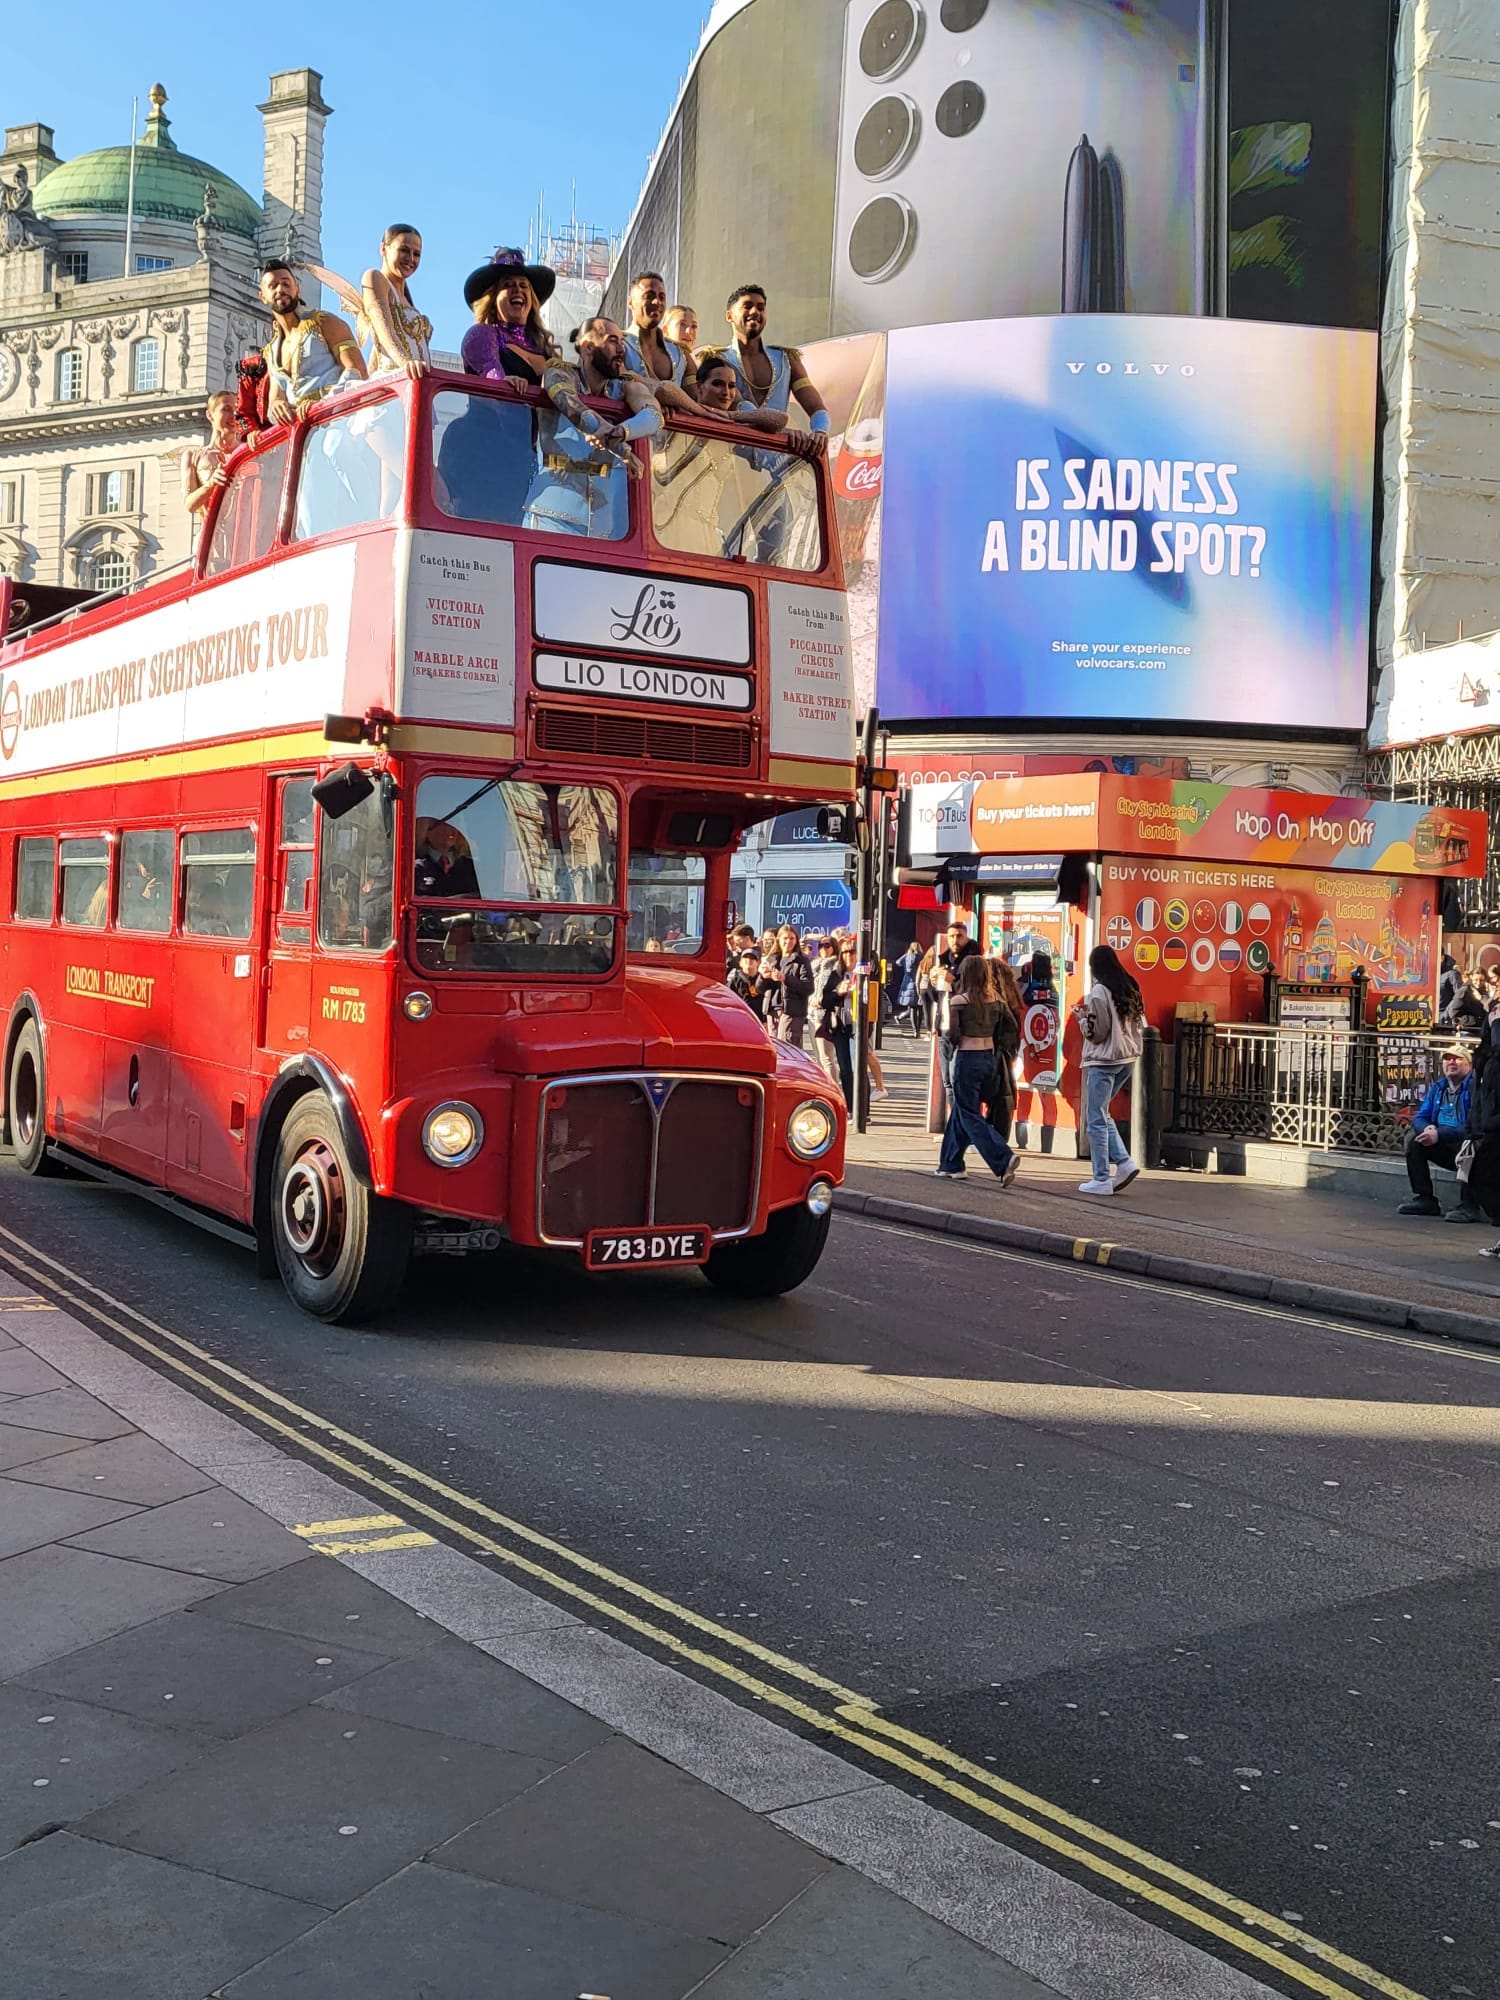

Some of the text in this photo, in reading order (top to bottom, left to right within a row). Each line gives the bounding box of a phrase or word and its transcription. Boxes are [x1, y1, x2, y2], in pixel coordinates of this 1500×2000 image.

[1065, 362, 1196, 377] VOLVO
[1015, 458, 1238, 515] IS SADNESS
[981, 519, 1266, 577] A BLIND SPOT?
[420, 554, 491, 573] Catch this Bus
[442, 568, 470, 581] from:
[427, 597, 485, 615] VICTORIA
[787, 605, 844, 623] Catch this Bus
[431, 613, 481, 630] STATION
[805, 618, 827, 630] from:
[789, 638, 845, 656] PICCADILLY
[1051, 640, 1192, 656] Share your experience
[23, 603, 329, 732] LONDON TRANSPORT SIGHTSEEING TOUR
[414, 650, 498, 670] MARBLE ARCH
[801, 653, 834, 668] CIRCUS
[1075, 657, 1166, 670] volvocars.com
[463, 671, 500, 685] CORNER)
[564, 661, 726, 701] LIO LONDON
[794, 667, 841, 682] (HAYMARKET)
[783, 690, 852, 710] BAKER STREET
[798, 707, 837, 721] STATION
[976, 802, 1096, 825] Buy your tickets here!
[1138, 820, 1181, 841] London
[1235, 810, 1376, 846] Hop On Hop Off
[1108, 866, 1275, 889] BUY YOUR TICKETS HERE
[771, 894, 845, 909] ILLUMINATED
[1335, 900, 1376, 920] London
[776, 910, 805, 925] by an
[66, 965, 155, 1009] LONDON TRANSPORT
[322, 997, 366, 1023] RM 1783
[1288, 1003, 1326, 1012] Bakerloo line
[1386, 1008, 1424, 1021] Passports
[601, 1235, 696, 1261] 783 DYE
